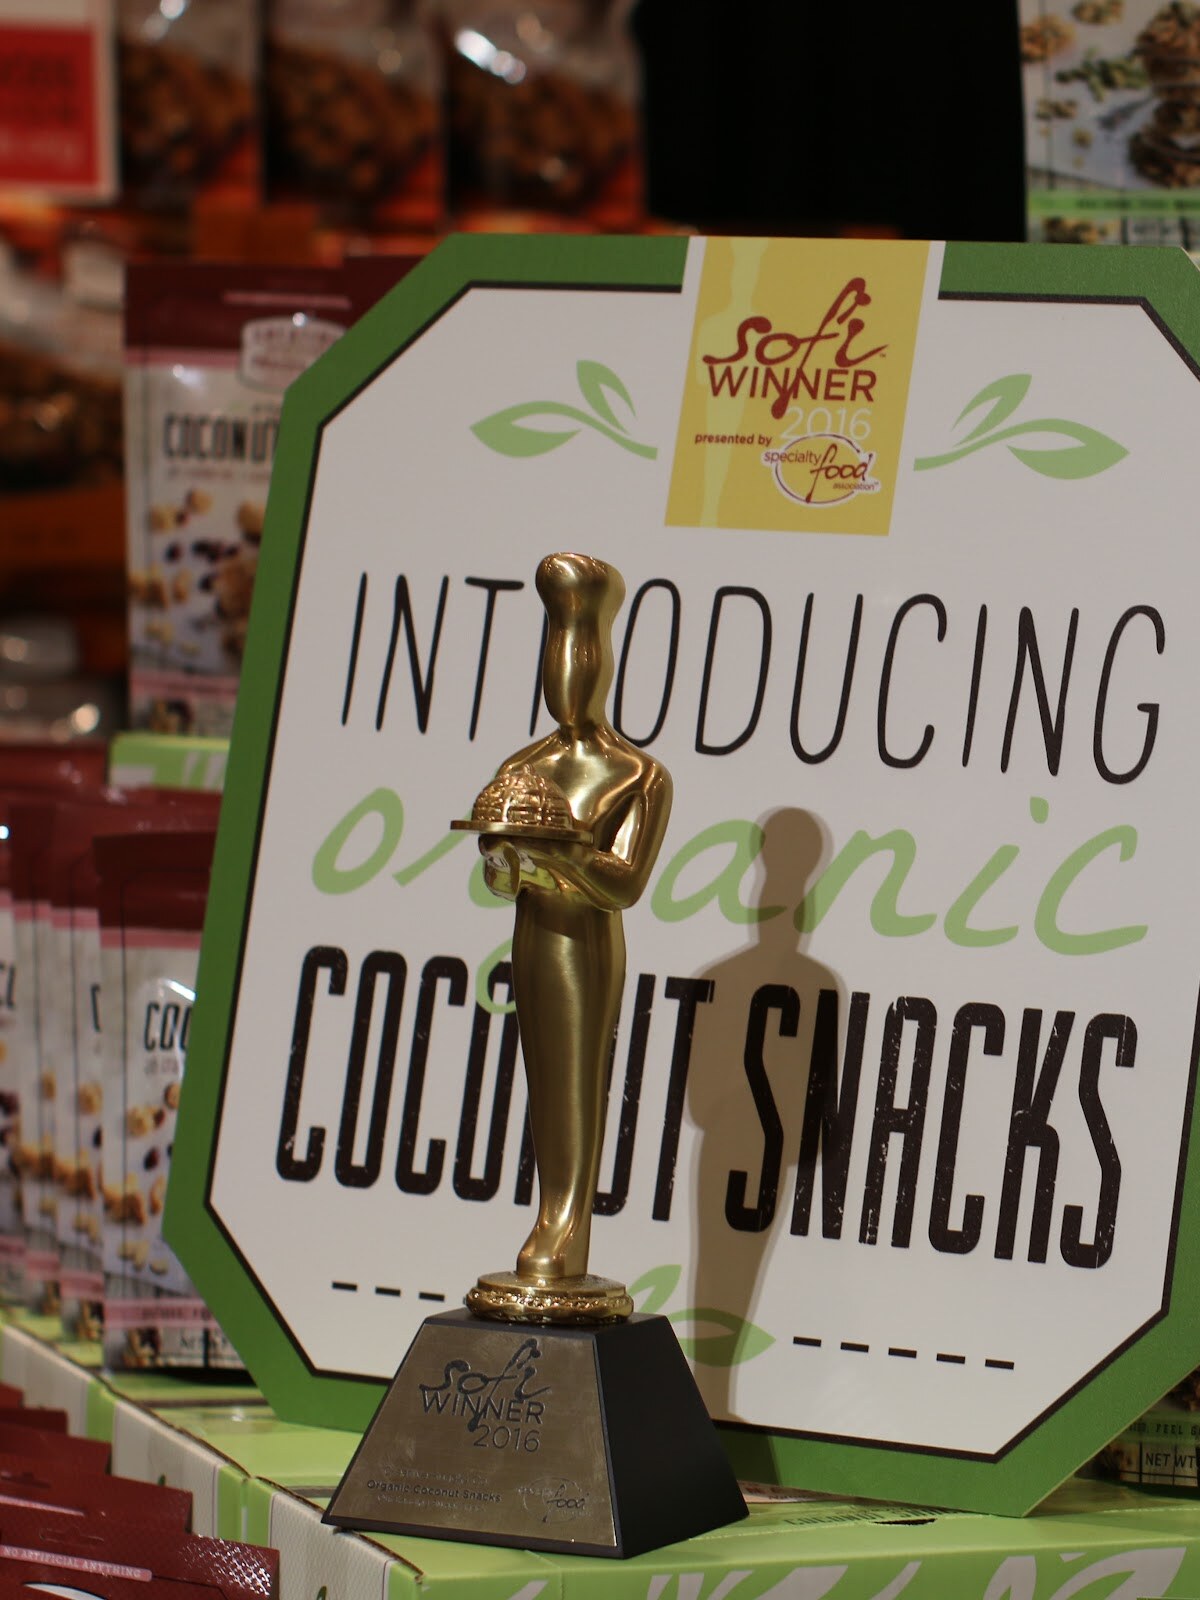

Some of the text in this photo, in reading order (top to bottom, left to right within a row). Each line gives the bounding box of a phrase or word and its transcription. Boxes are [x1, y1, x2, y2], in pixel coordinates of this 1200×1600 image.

[708, 365, 877, 402] WINNER
[694, 433, 772, 446] presented by
[781, 406, 872, 441] 2016
[764, 449, 821, 464] specialty
[805, 443, 873, 503] food
[340, 572, 1166, 784] INTODUCING
[276, 945, 1137, 1269] COCOUT SNACKS
[421, 1388, 546, 1425] WINNER
[474, 1423, 540, 1452] 2016
[1156, 1424, 1183, 1436] FEEL
[1145, 1452, 1171, 1468] NET
[1174, 1455, 1194, 1469] WT
[367, 1479, 409, 1494] Organic
[413, 1484, 459, 1498] Coconut
[463, 1490, 501, 1502] Snacks
[5, 1546, 142, 1578] NO ARTIFICIAL ANYTHING
